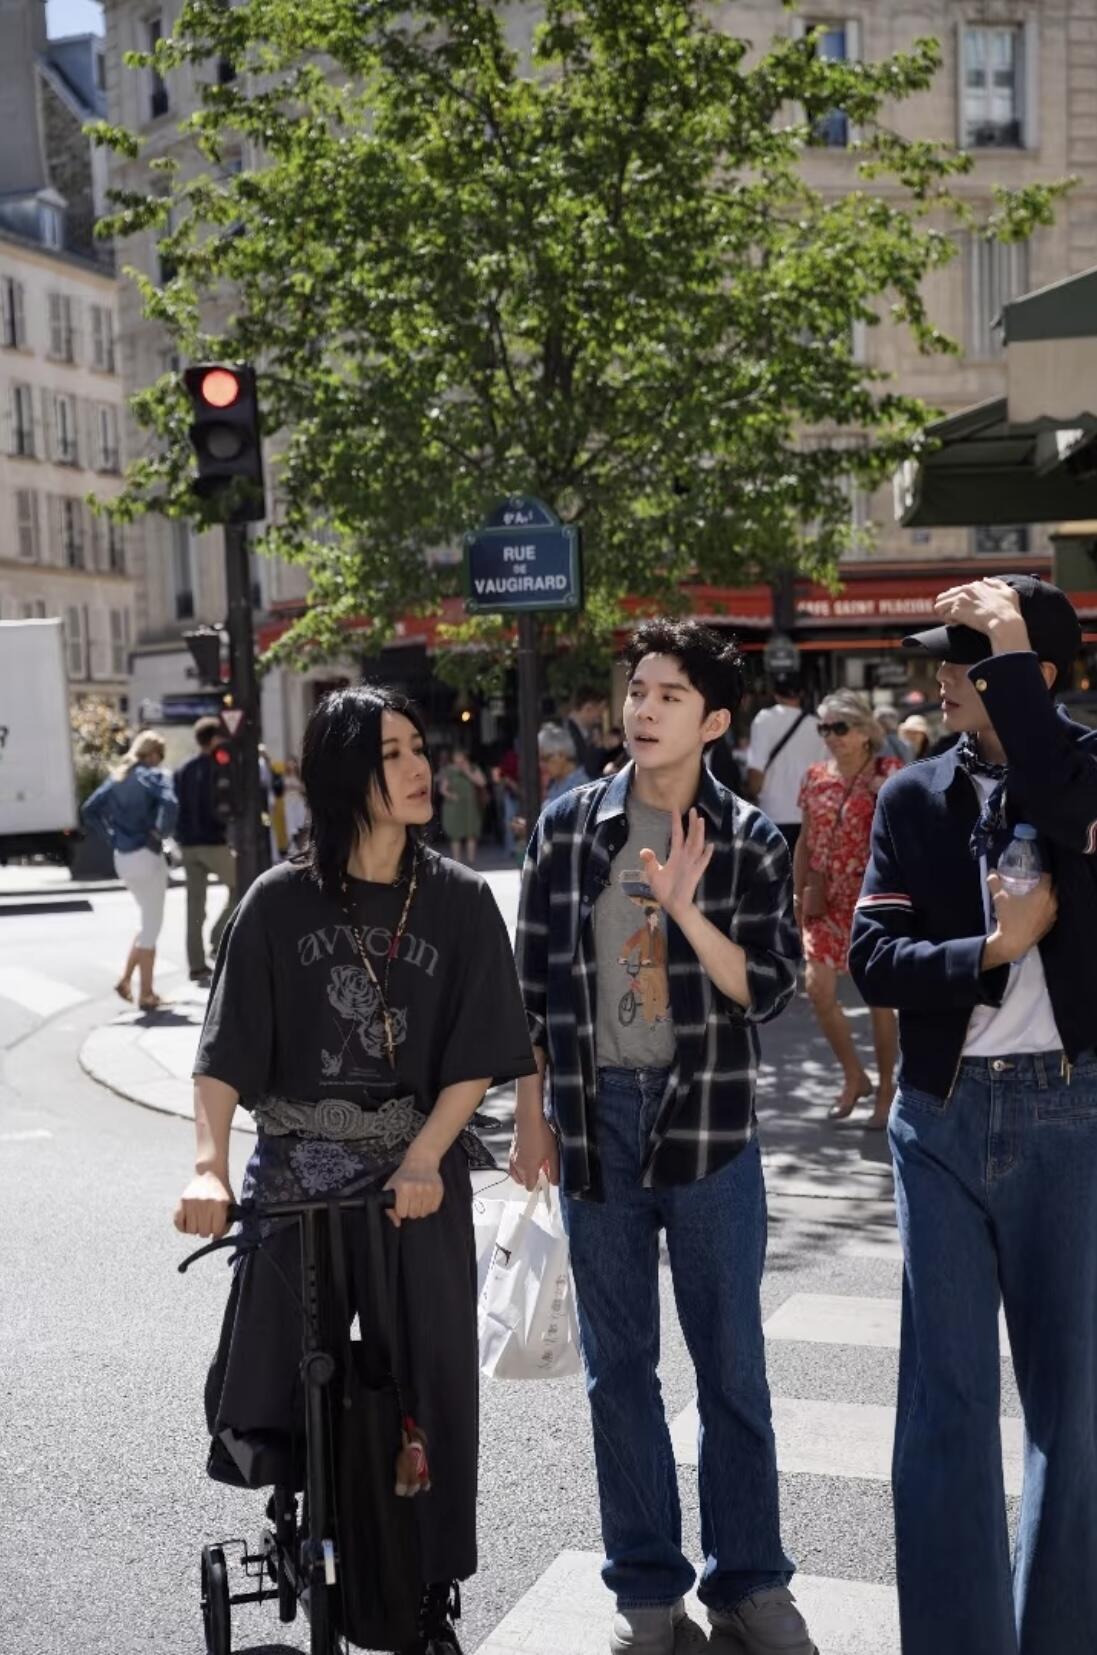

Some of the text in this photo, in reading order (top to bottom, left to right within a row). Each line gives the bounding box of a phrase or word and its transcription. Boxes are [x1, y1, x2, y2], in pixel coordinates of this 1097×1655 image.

[503, 545, 536, 562] RUE
[513, 564, 527, 575] DE
[475, 575, 567, 595] VAUGIRARD
